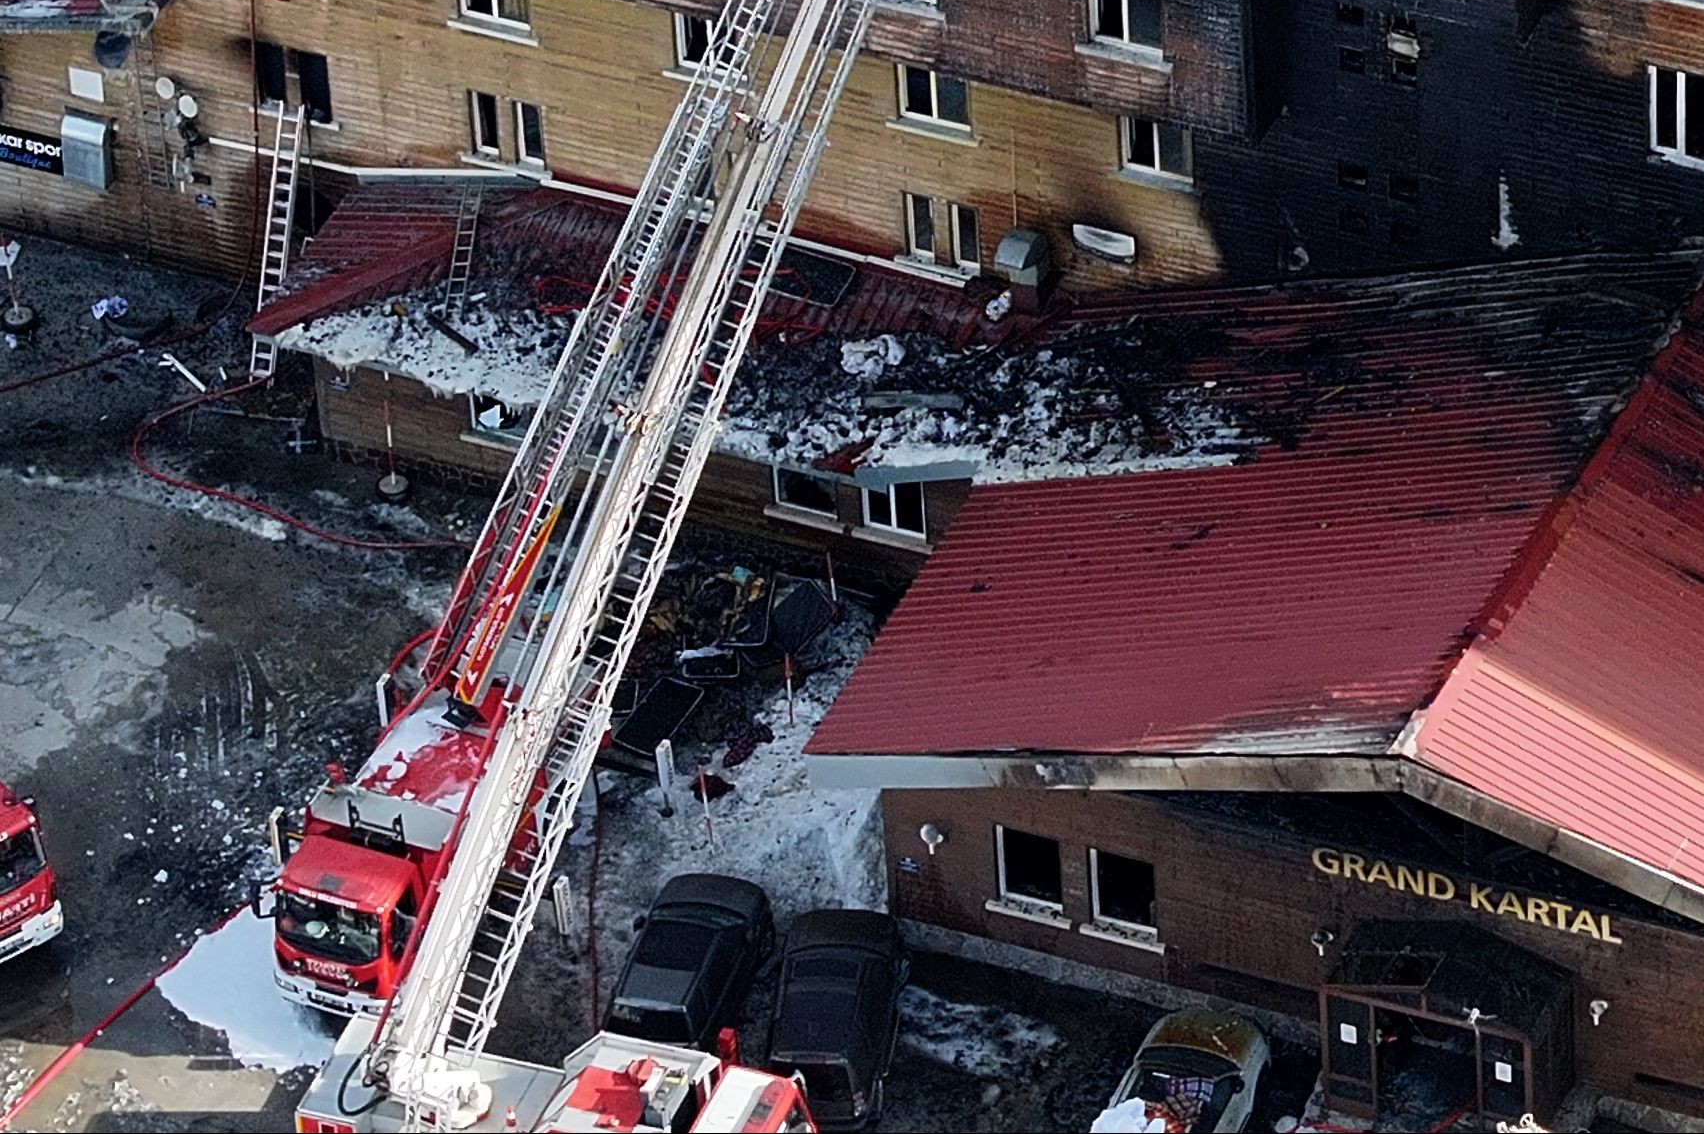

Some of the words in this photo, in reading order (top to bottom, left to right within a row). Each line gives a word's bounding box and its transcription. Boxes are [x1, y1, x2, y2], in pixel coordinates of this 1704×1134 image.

[25, 139, 61, 157] spor
[1311, 847, 1455, 900] GRAND
[1469, 883, 1622, 944] KARTAL
